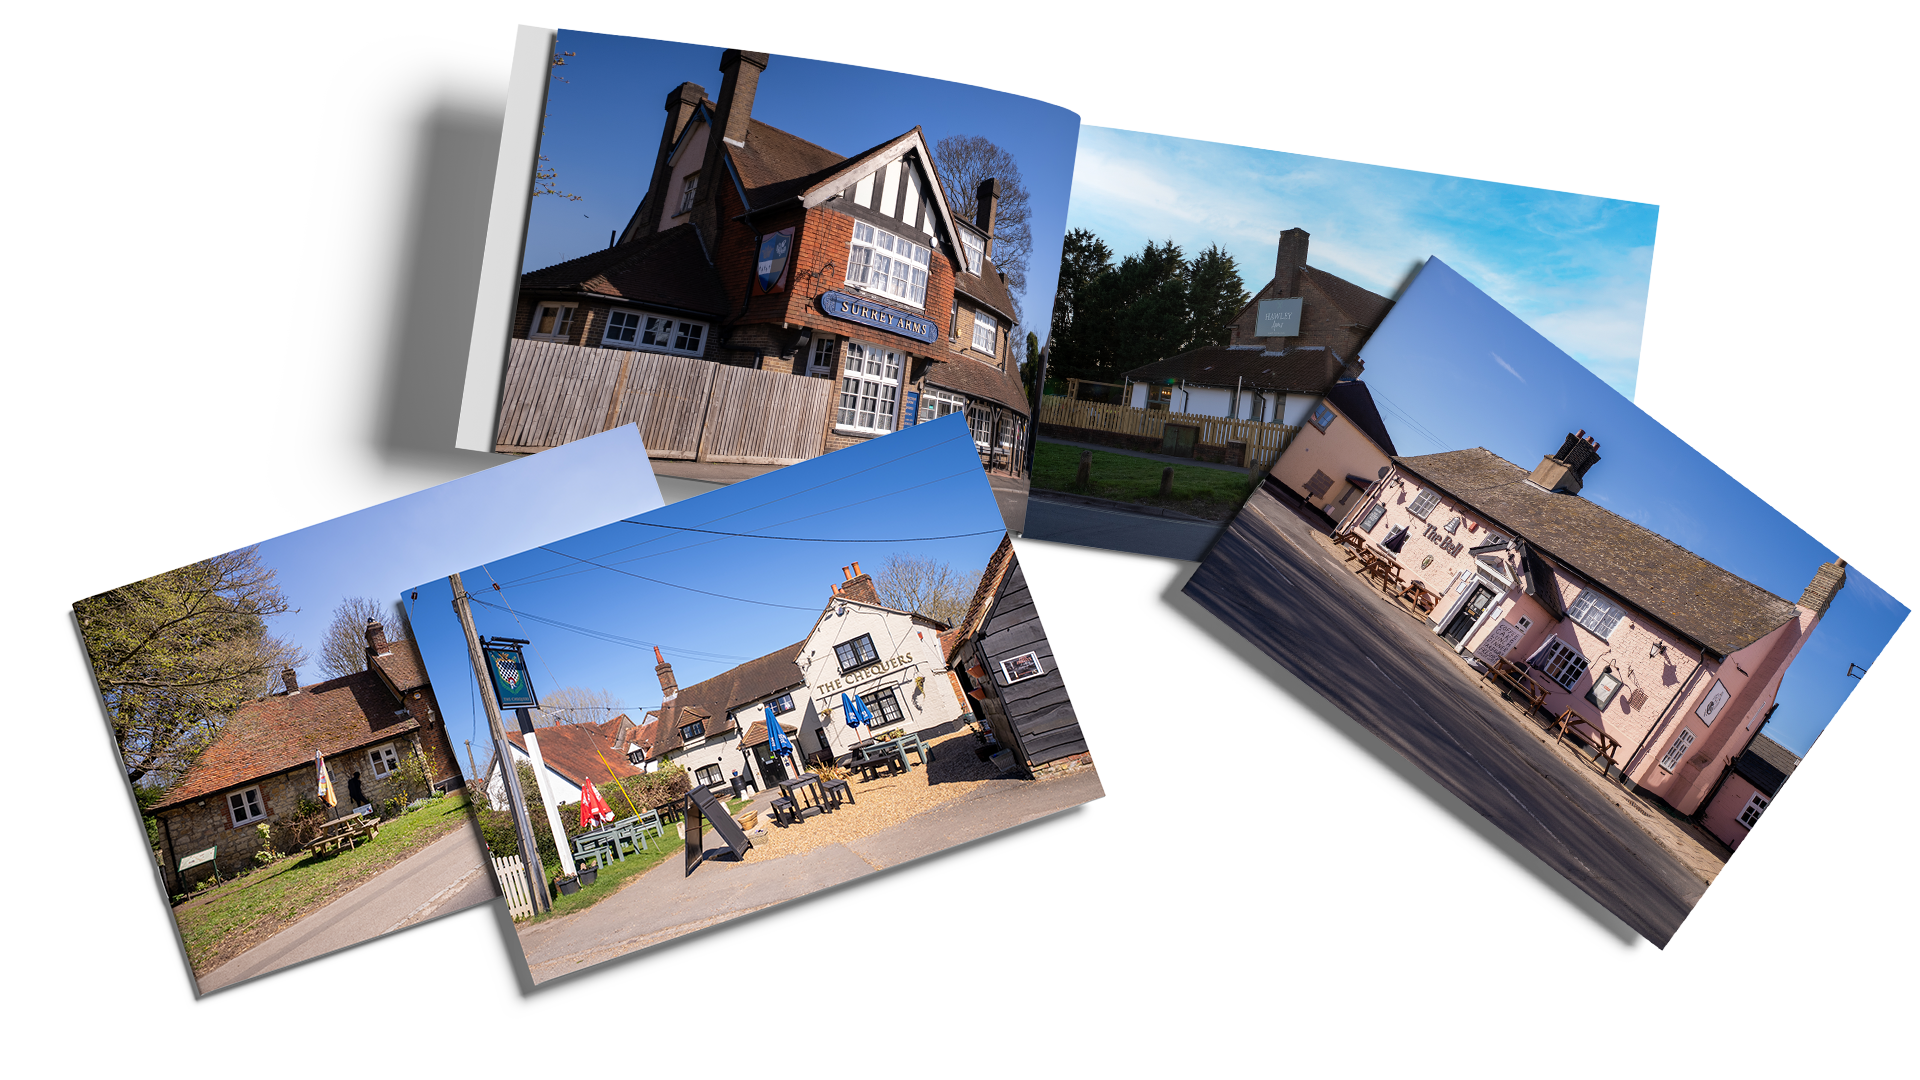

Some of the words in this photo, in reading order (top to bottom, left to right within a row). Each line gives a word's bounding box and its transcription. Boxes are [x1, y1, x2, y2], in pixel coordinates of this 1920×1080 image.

[841, 301, 895, 325] SURREY
[897, 318, 927, 335] ARMS
[1265, 312, 1293, 321] HAWLEY
[1423, 522, 1443, 546] The
[1439, 535, 1464, 558] Bell
[1494, 627, 1516, 644] CAKE
[1498, 622, 1520, 639] COFFEE
[1490, 632, 1511, 648] LUNCH
[816, 678, 843, 695] THE
[845, 652, 914, 685] CHEQUERS
